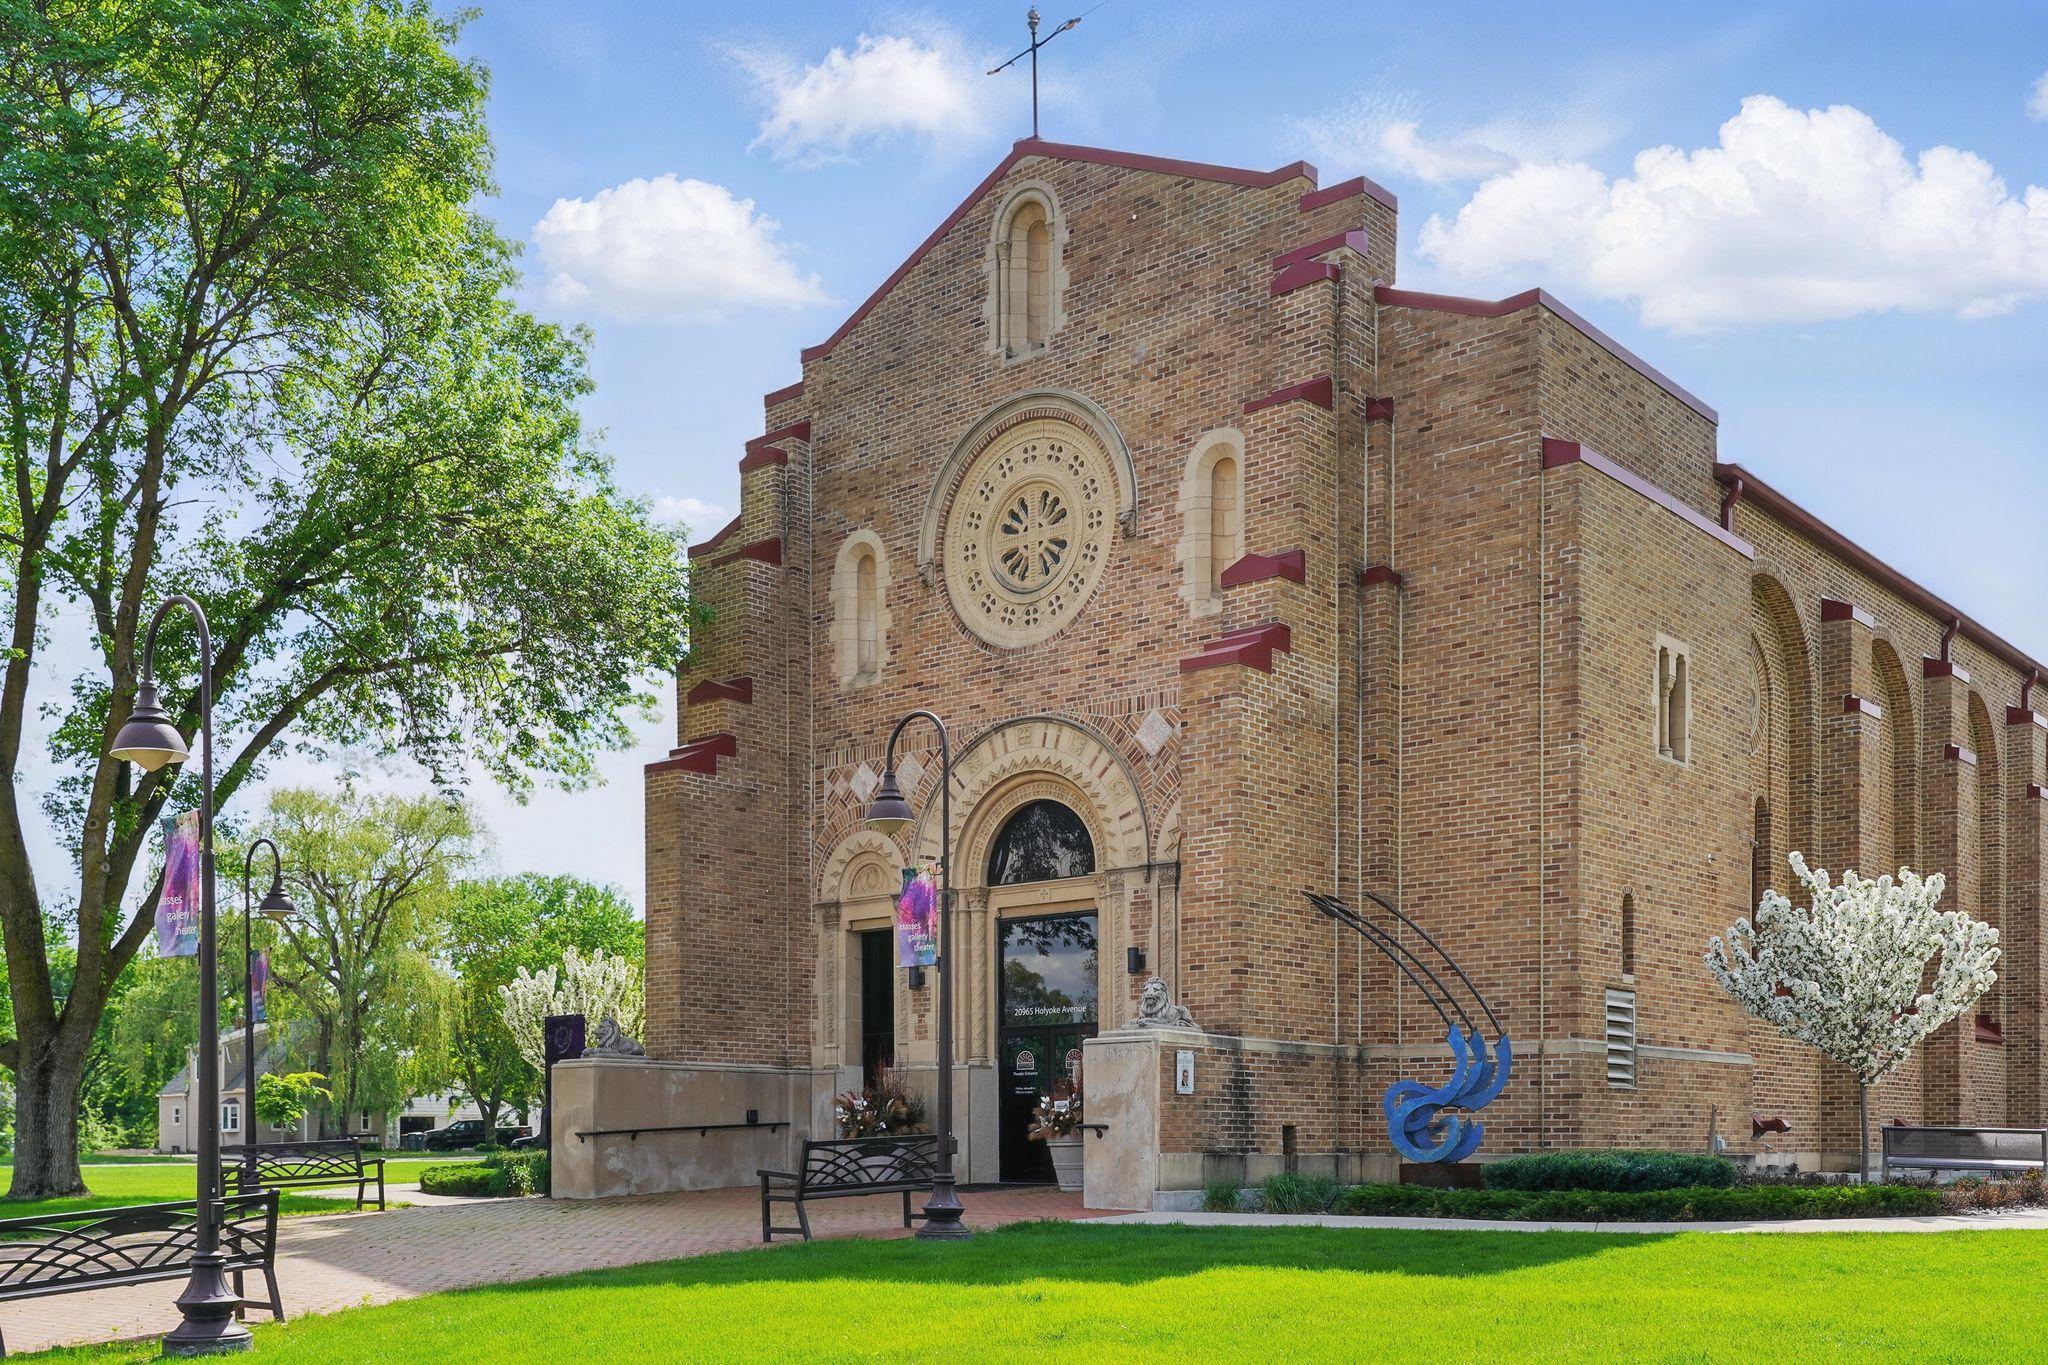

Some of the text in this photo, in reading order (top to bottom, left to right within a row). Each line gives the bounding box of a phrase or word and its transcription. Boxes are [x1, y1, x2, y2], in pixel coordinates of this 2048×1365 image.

[160, 896, 183, 905] lasses
[167, 909, 190, 922] gallery
[175, 926, 197, 936] theater
[908, 933, 929, 942] gallery
[1014, 1005, 1087, 1016] 20965 Holyoke Avenue
